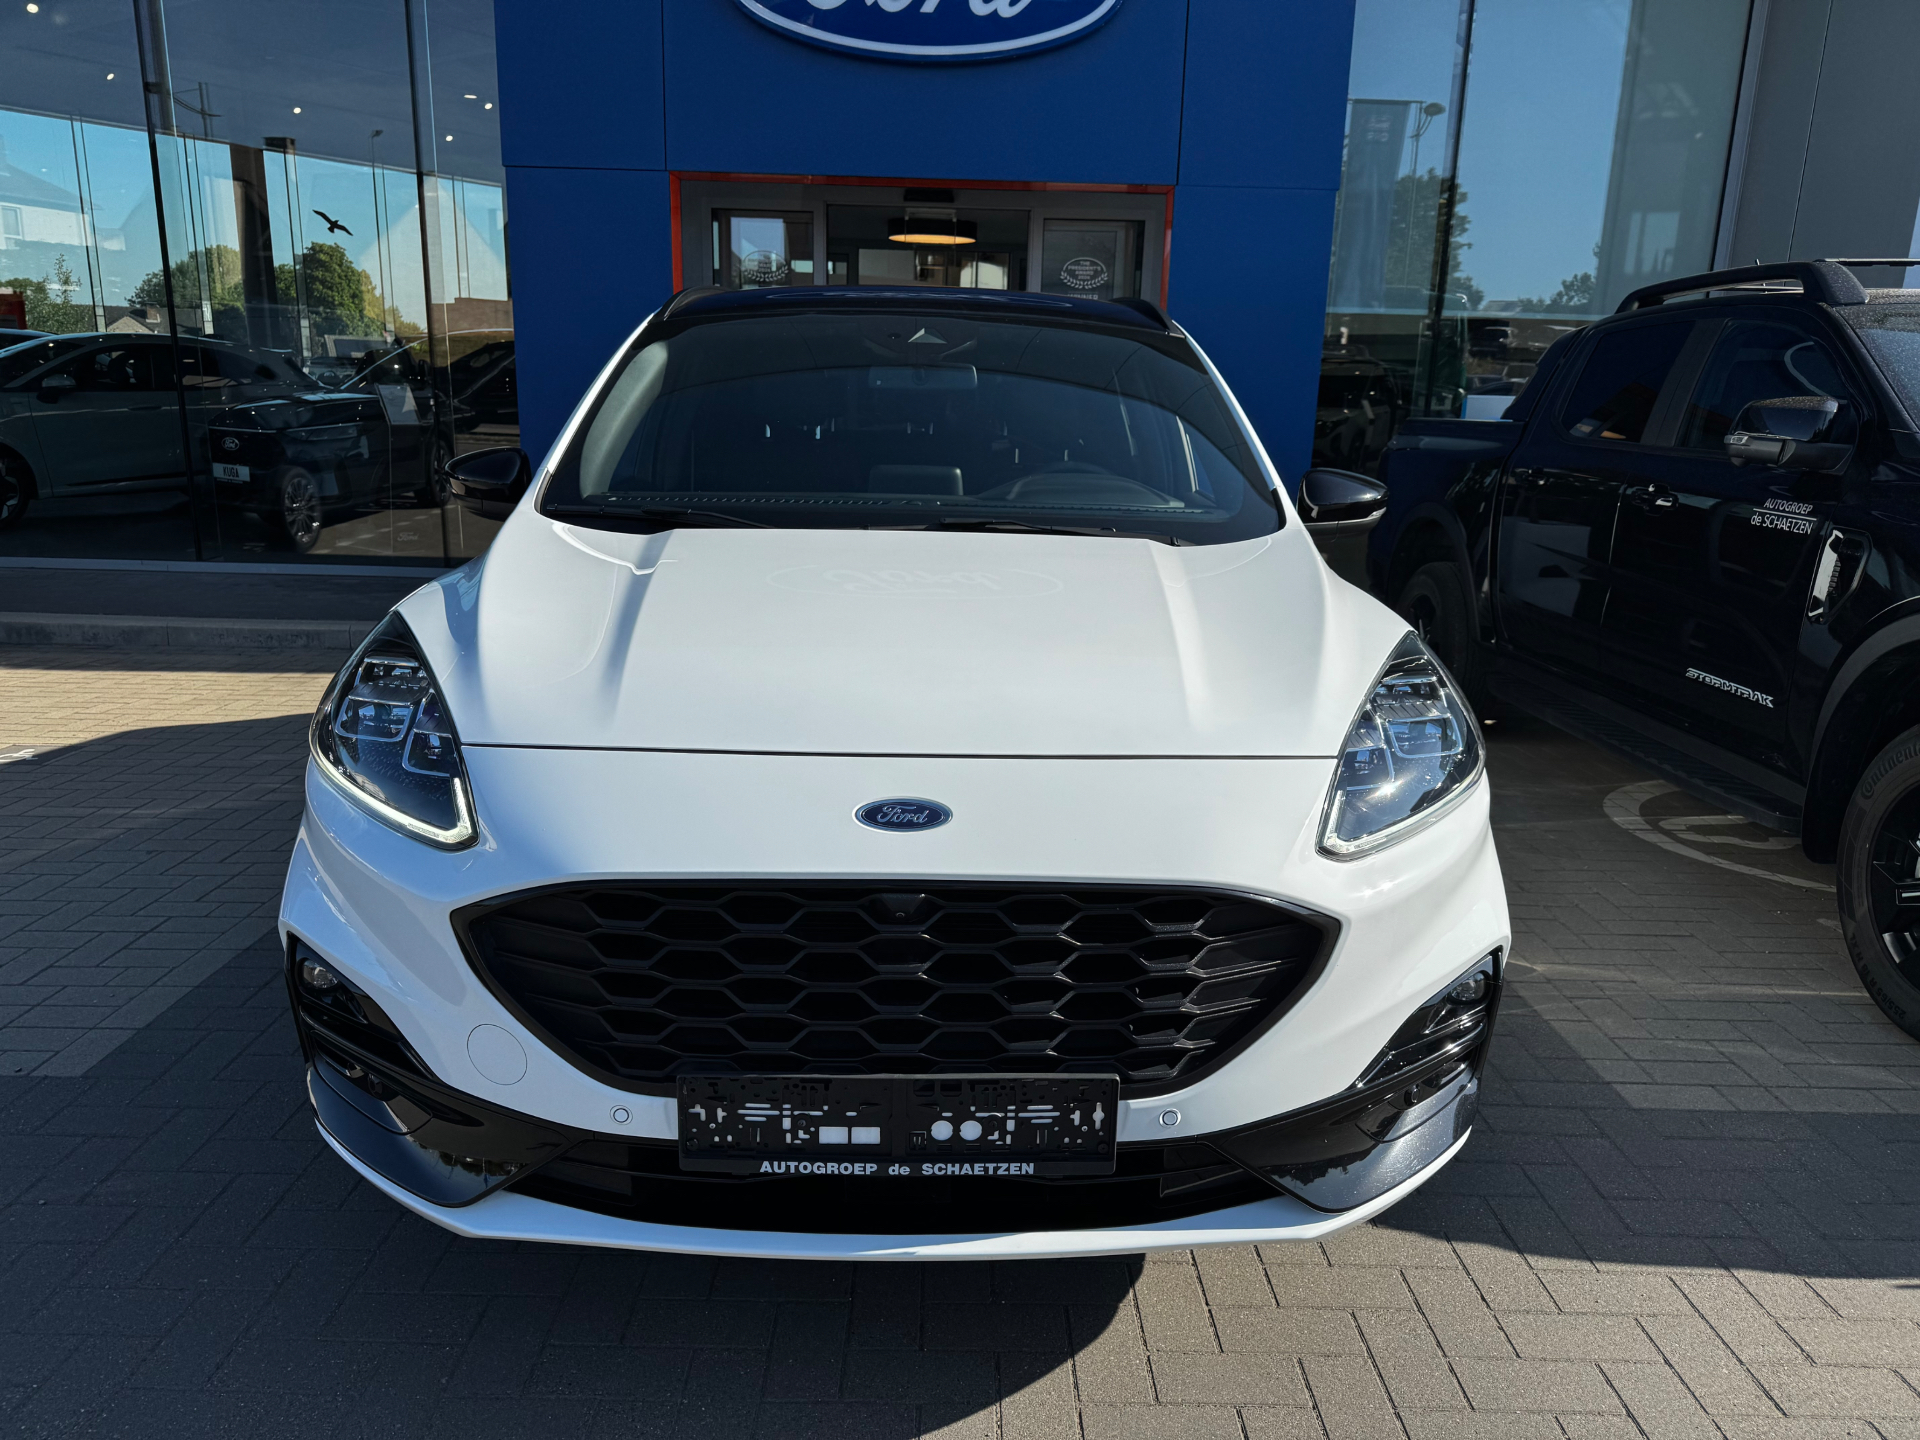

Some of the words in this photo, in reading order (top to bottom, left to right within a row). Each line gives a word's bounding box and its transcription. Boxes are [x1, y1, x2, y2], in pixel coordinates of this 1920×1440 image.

[222, 466, 239, 478] KUGA
[1763, 498, 1813, 514] AUTOGROEP
[1750, 513, 1762, 526] de
[1762, 514, 1813, 535] SCHAETZEN
[1685, 667, 1774, 709] STORMTRAK
[876, 804, 930, 823] Ford
[760, 1161, 878, 1175] AUTOGROEP
[888, 1164, 911, 1175] de
[921, 1163, 1034, 1175] SCHAETZEN
